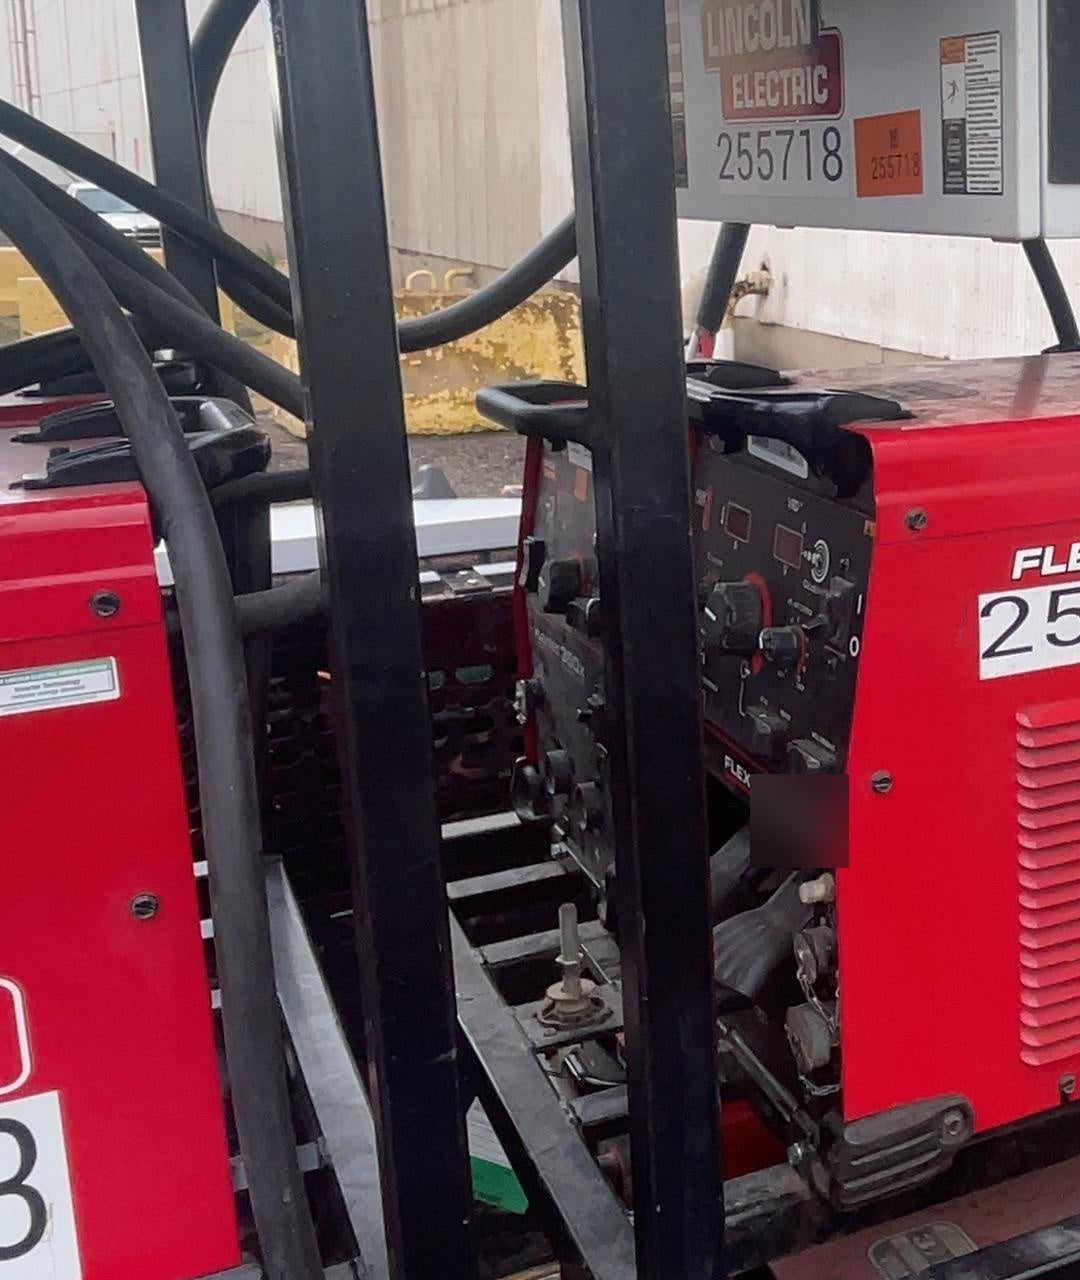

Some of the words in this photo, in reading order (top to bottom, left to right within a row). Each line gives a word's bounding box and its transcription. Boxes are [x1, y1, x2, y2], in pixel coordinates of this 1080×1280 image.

[732, 62, 829, 109] ELECTRIC
[717, 126, 843, 181] 255718
[871, 152, 921, 180] 255718
